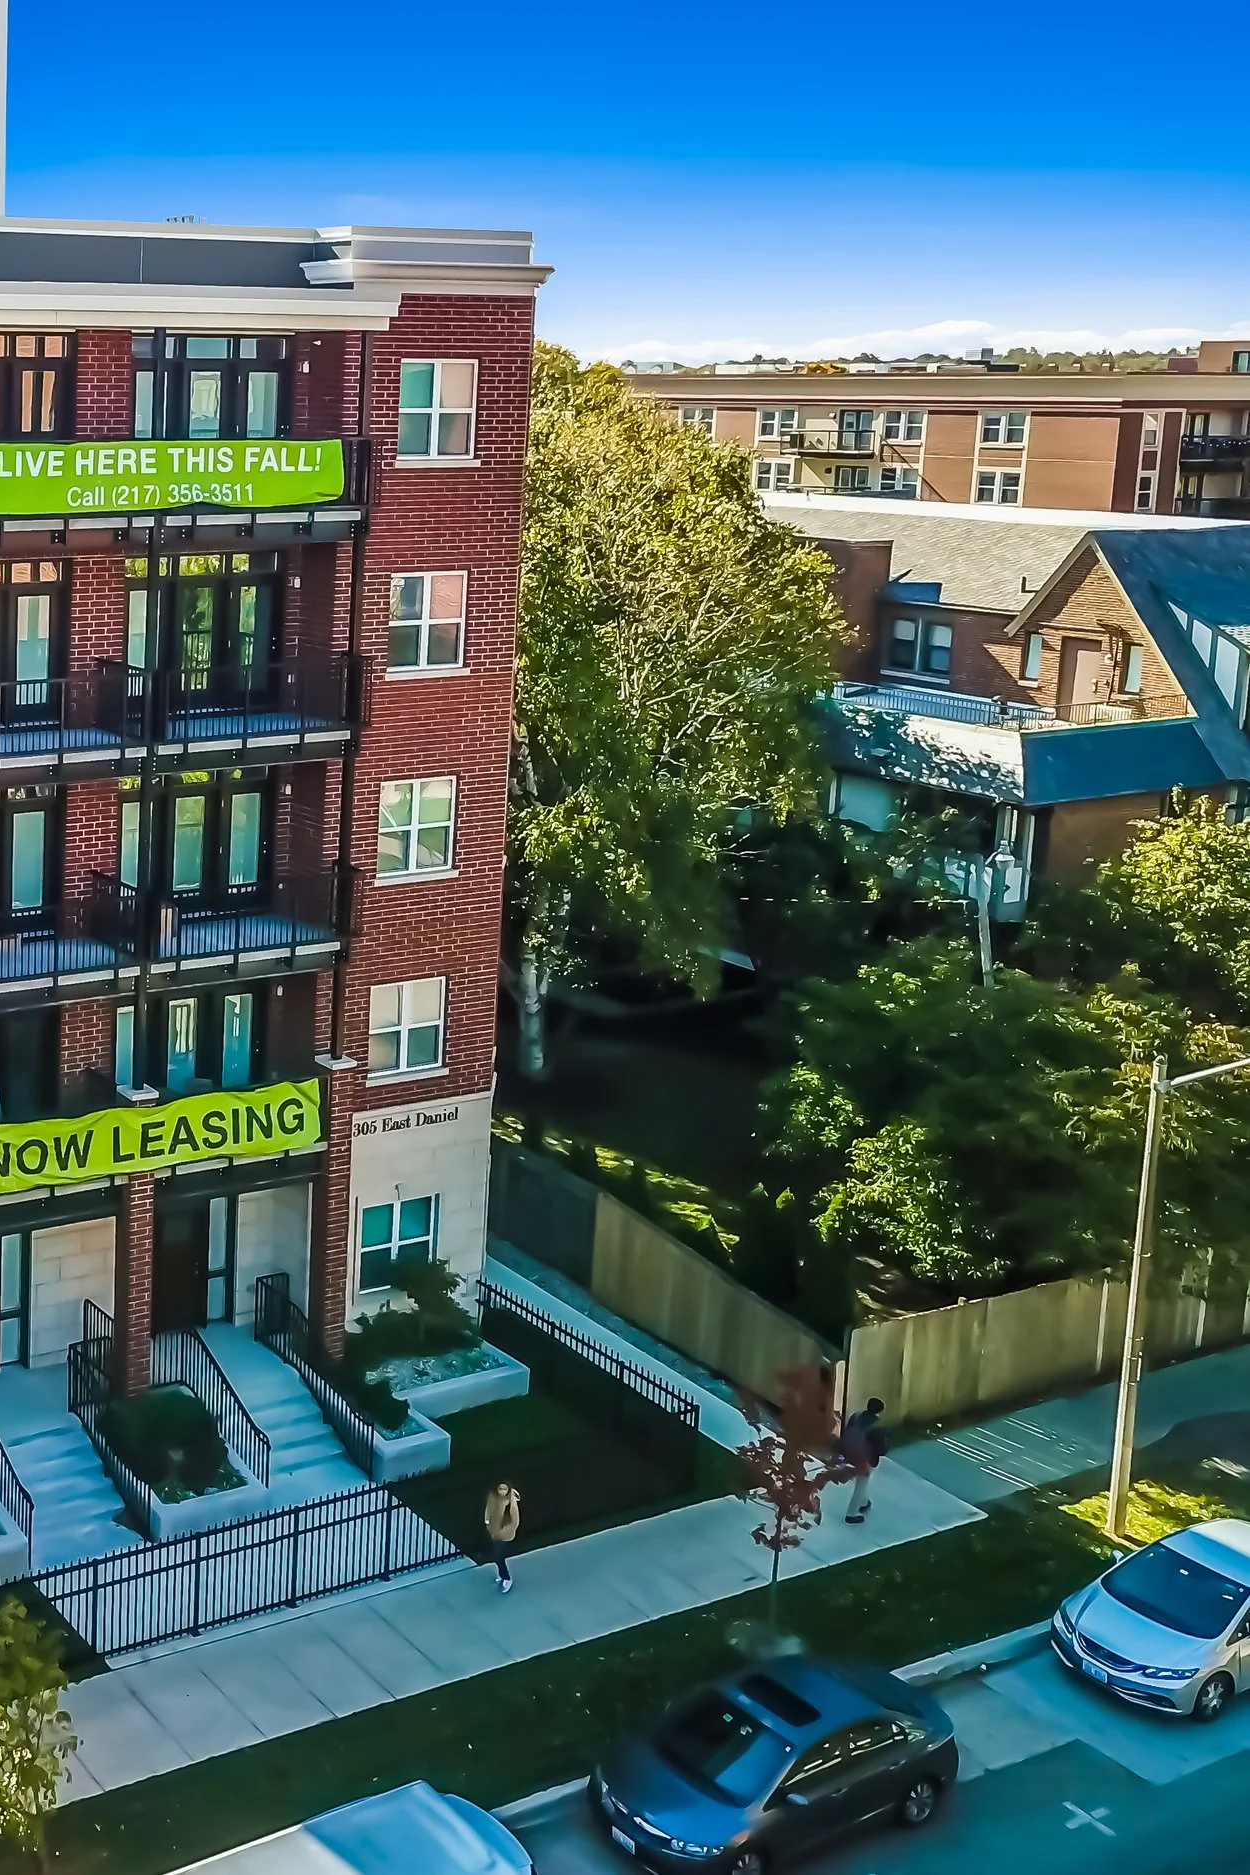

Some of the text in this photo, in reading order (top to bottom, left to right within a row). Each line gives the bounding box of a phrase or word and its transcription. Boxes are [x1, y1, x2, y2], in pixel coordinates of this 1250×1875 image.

[75, 448, 157, 476] HERE
[167, 447, 234, 473] THIS
[245, 447, 322, 472] FALL!
[67, 483, 254, 507] Call (217) 356-3511
[112, 1098, 306, 1164] LEASING
[353, 1106, 459, 1138] 305 East Daniel
